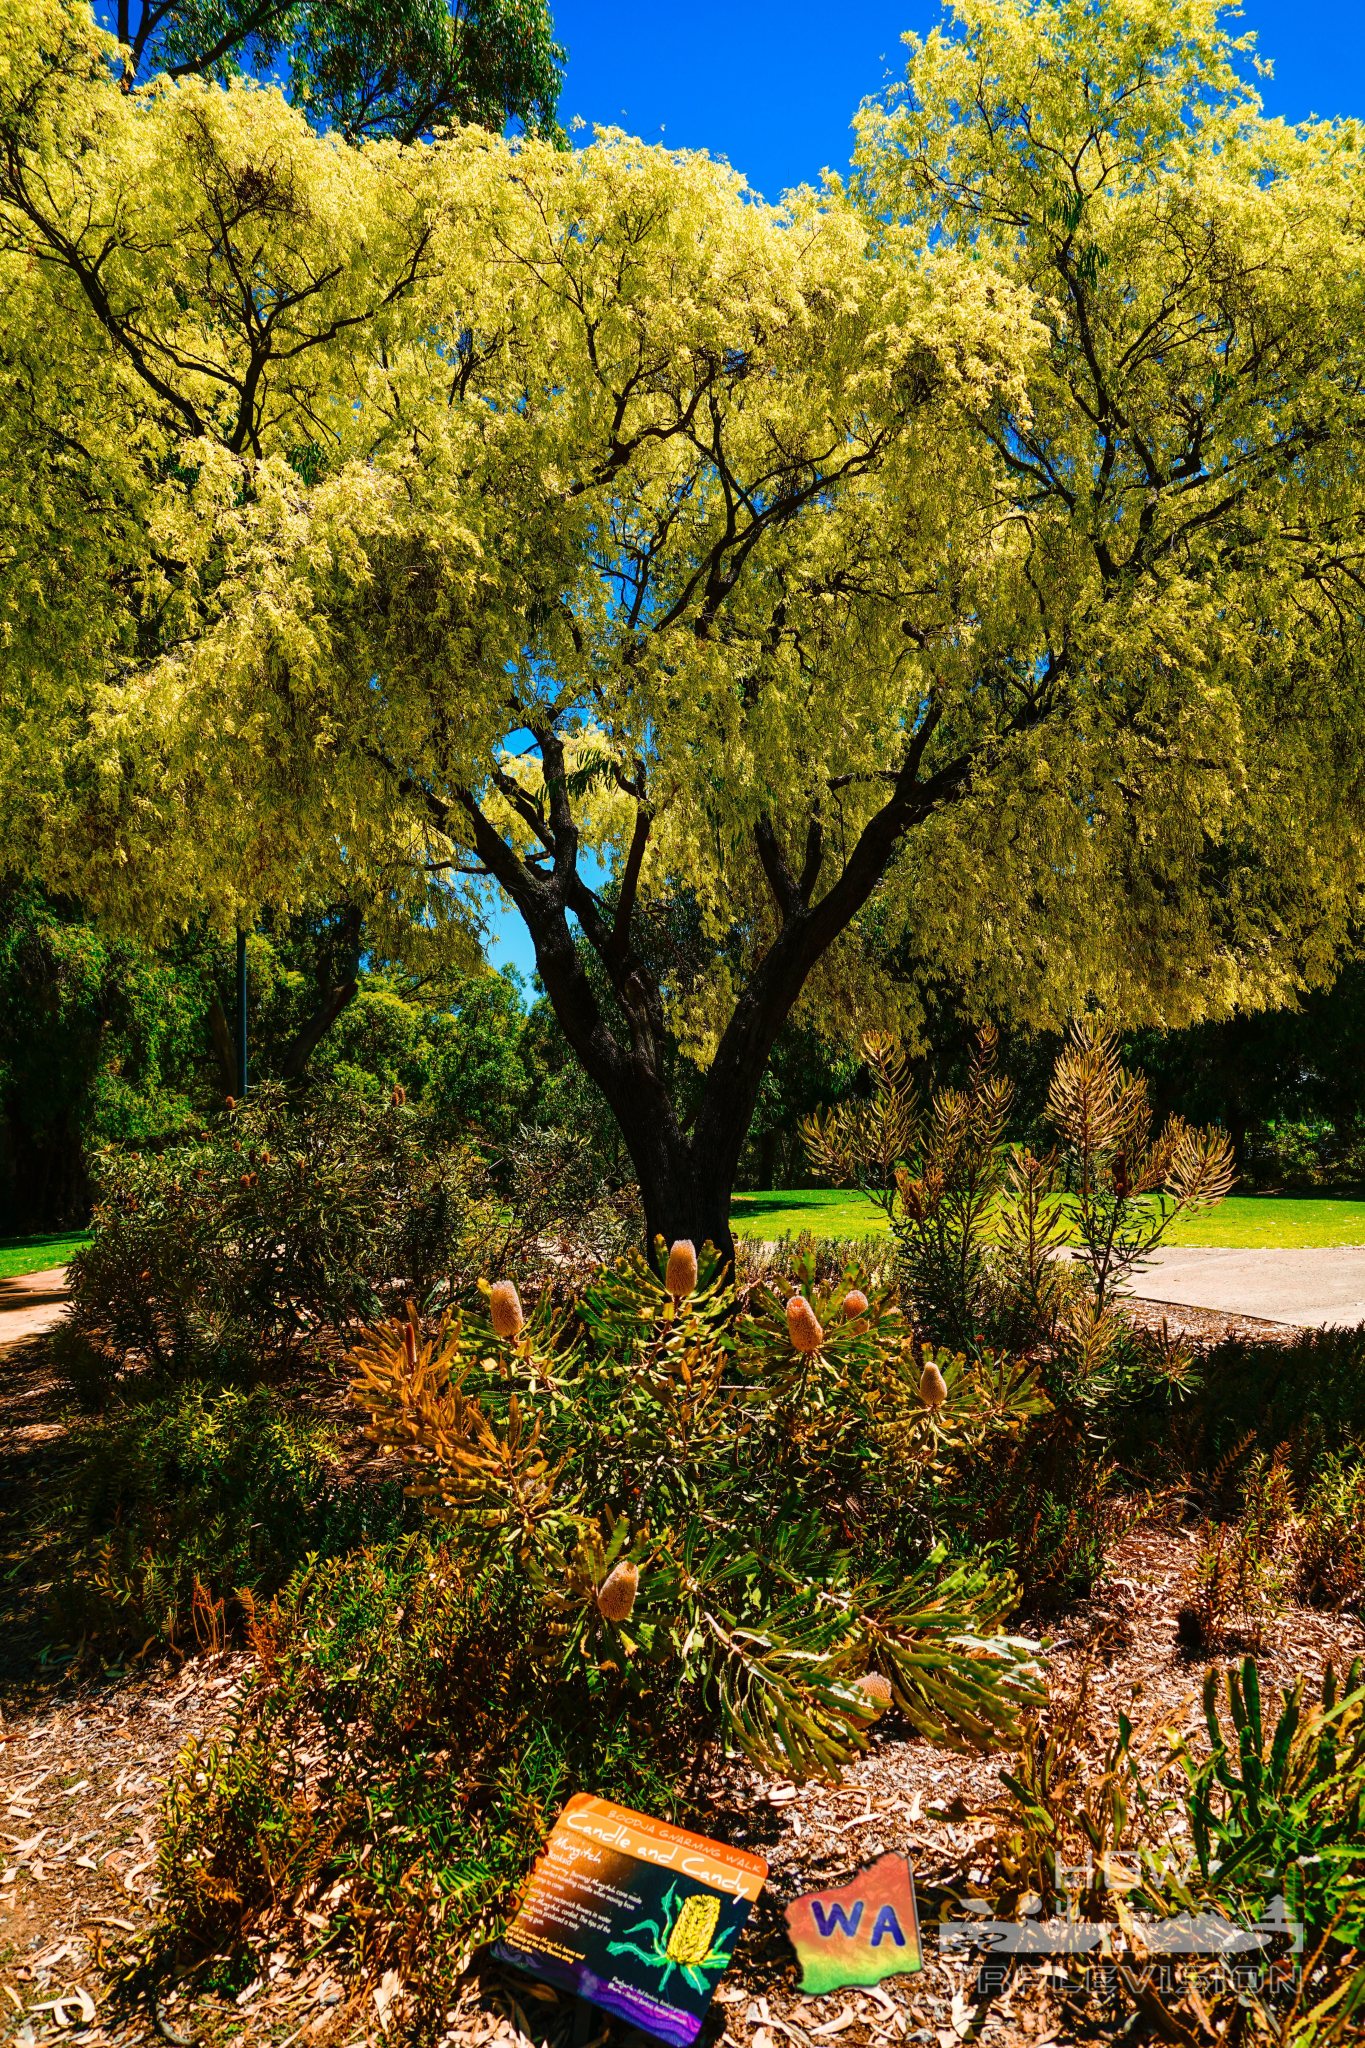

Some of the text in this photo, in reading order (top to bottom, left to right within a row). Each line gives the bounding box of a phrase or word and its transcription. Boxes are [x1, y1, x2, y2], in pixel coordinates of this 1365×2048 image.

[547, 1850, 572, 1866] Banksia
[553, 1837, 601, 1863] Mungitch
[566, 1813, 749, 1905] Candle and Candy
[607, 1810, 655, 1834] BOODJA
[726, 1854, 761, 1873] WALK
